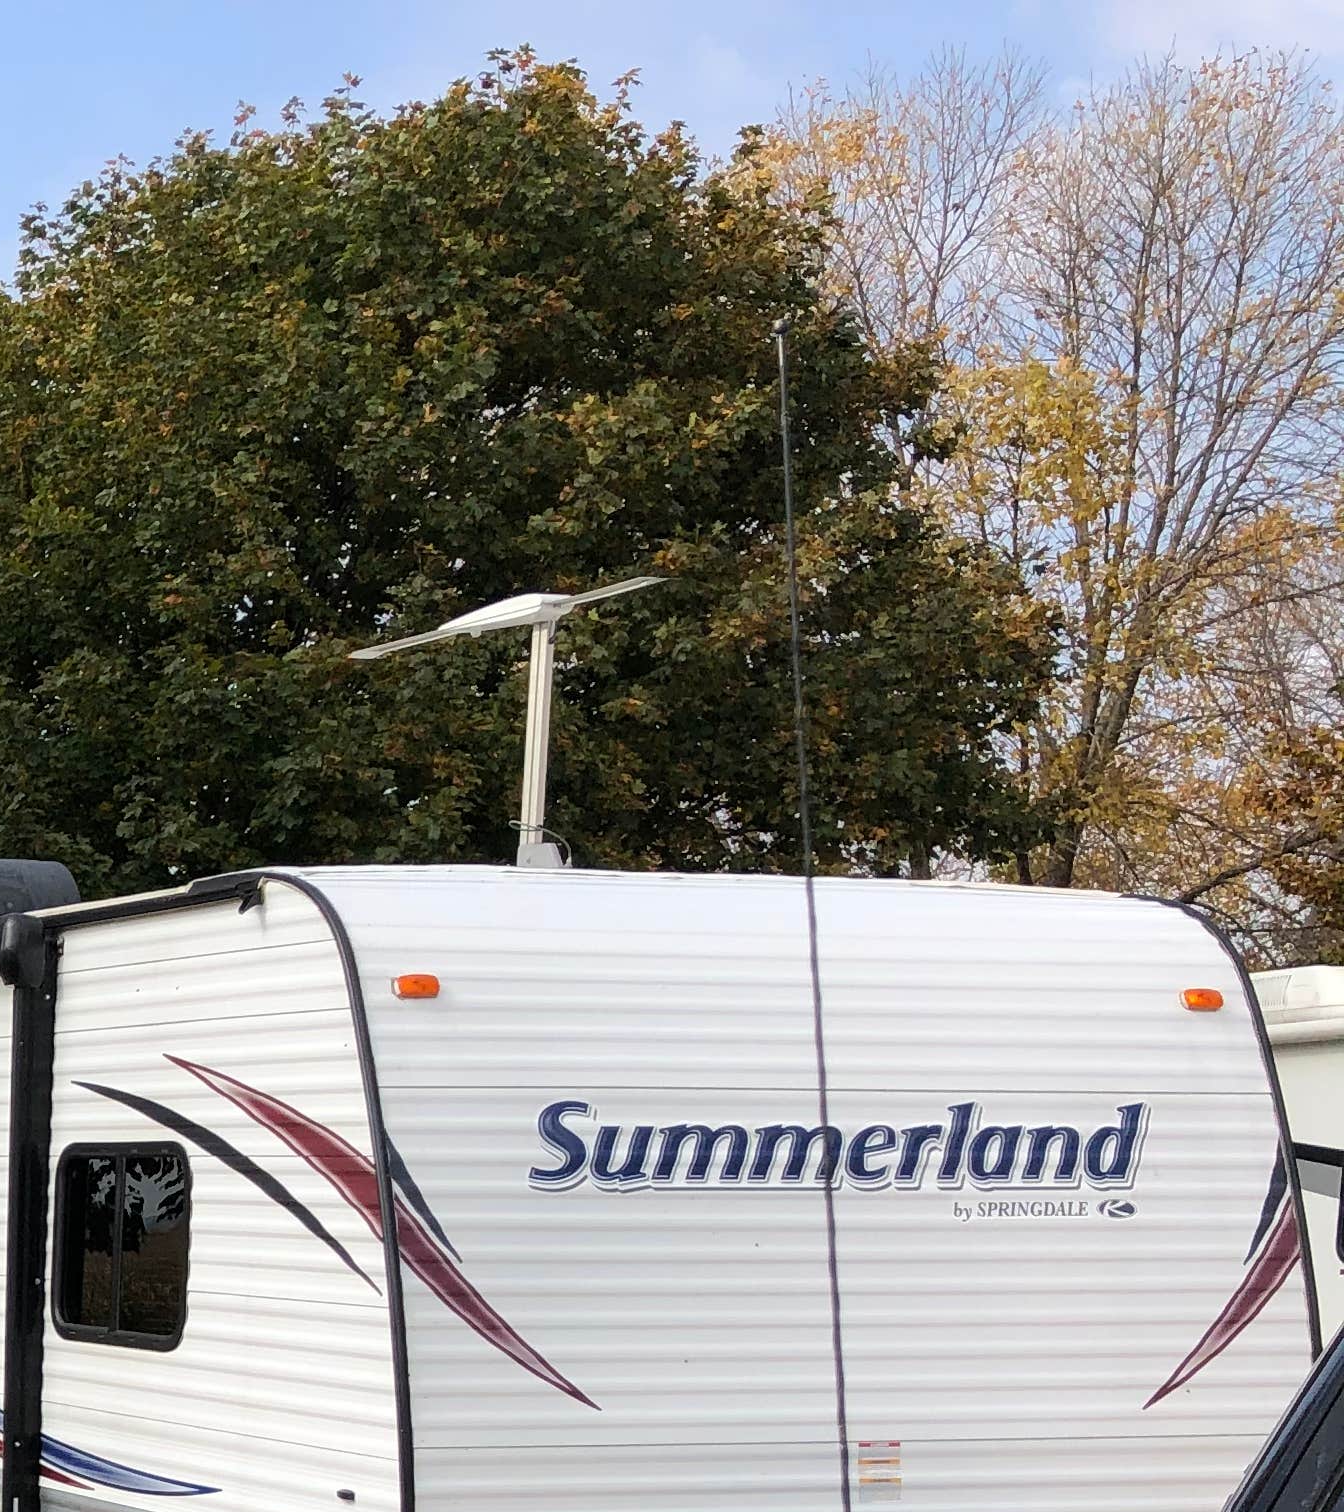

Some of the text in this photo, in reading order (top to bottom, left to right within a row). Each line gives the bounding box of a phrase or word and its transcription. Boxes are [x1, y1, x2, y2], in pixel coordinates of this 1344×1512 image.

[528, 1100, 1149, 1189] Summerland
[953, 1201, 973, 1222] by
[976, 1201, 1089, 1217] SPRINGDALE
